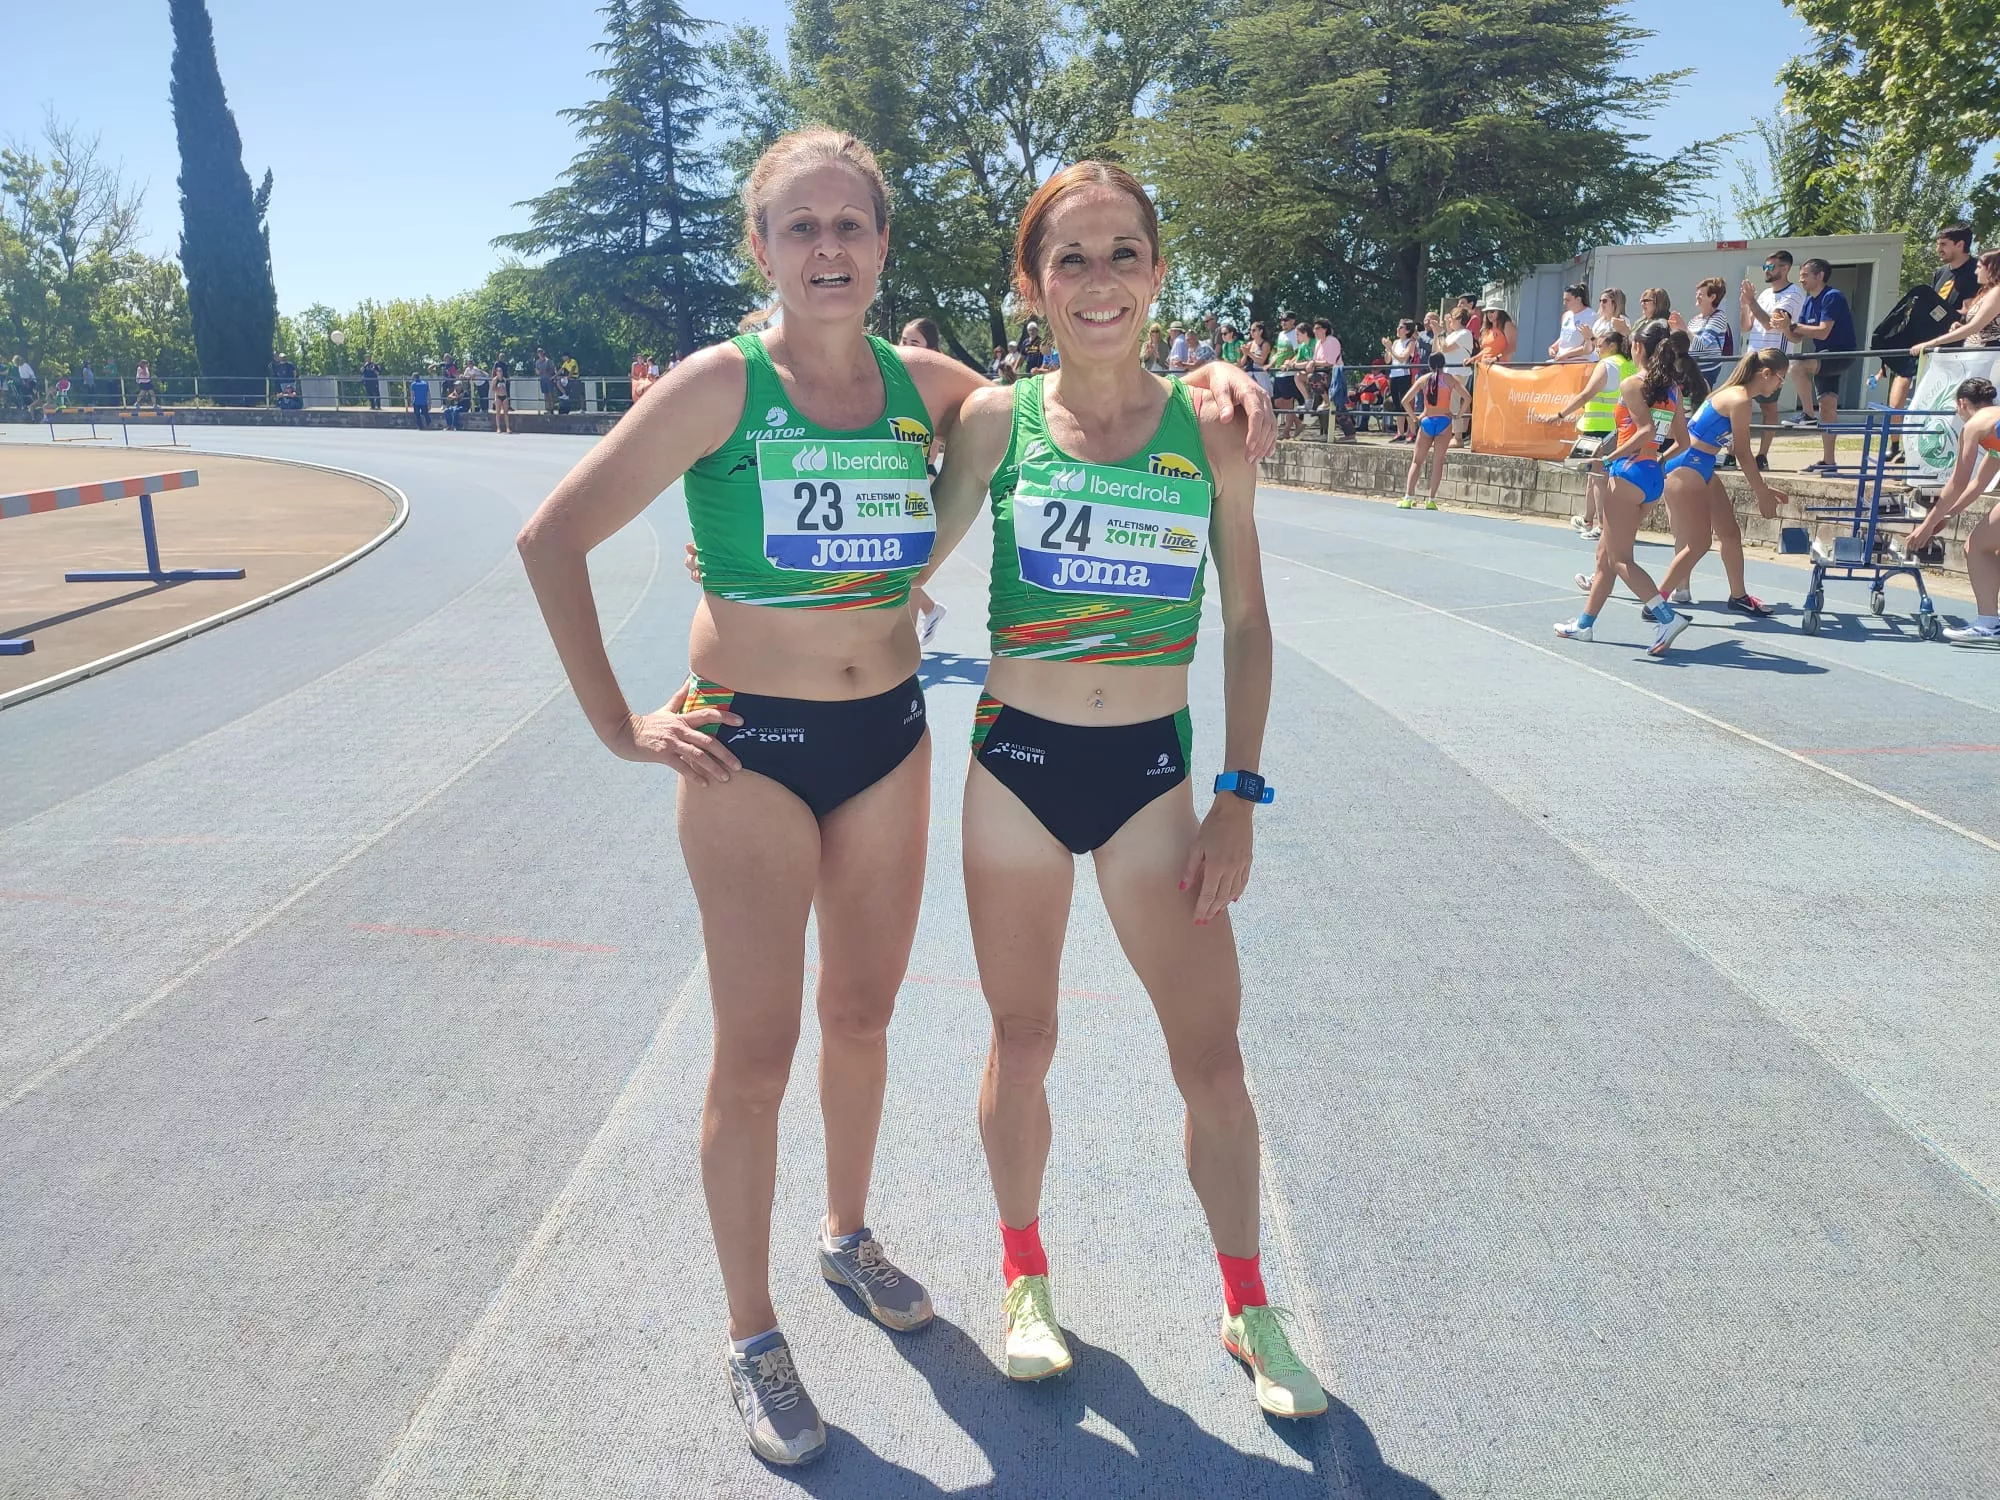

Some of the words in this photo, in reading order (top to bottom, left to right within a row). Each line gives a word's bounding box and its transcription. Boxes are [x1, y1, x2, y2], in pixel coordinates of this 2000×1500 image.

[1508, 388, 1574, 405] Ayuntamient
[745, 427, 806, 441] VIATOR
[832, 452, 908, 470] Iberdrola
[856, 493, 900, 501] ATLETISMO
[1089, 474, 1181, 505] Iberdrola
[793, 481, 844, 531] 23
[856, 502, 901, 518] ZOITI
[1040, 500, 1093, 552] 24
[1107, 518, 1160, 533] ATLETISMO
[1103, 528, 1157, 549] ZOITI
[758, 733, 805, 743] ZOITI
[1010, 749, 1045, 765] ZOITI
[1011, 743, 1046, 755] ATLETISMO
[1146, 765, 1177, 776] VIATOR
